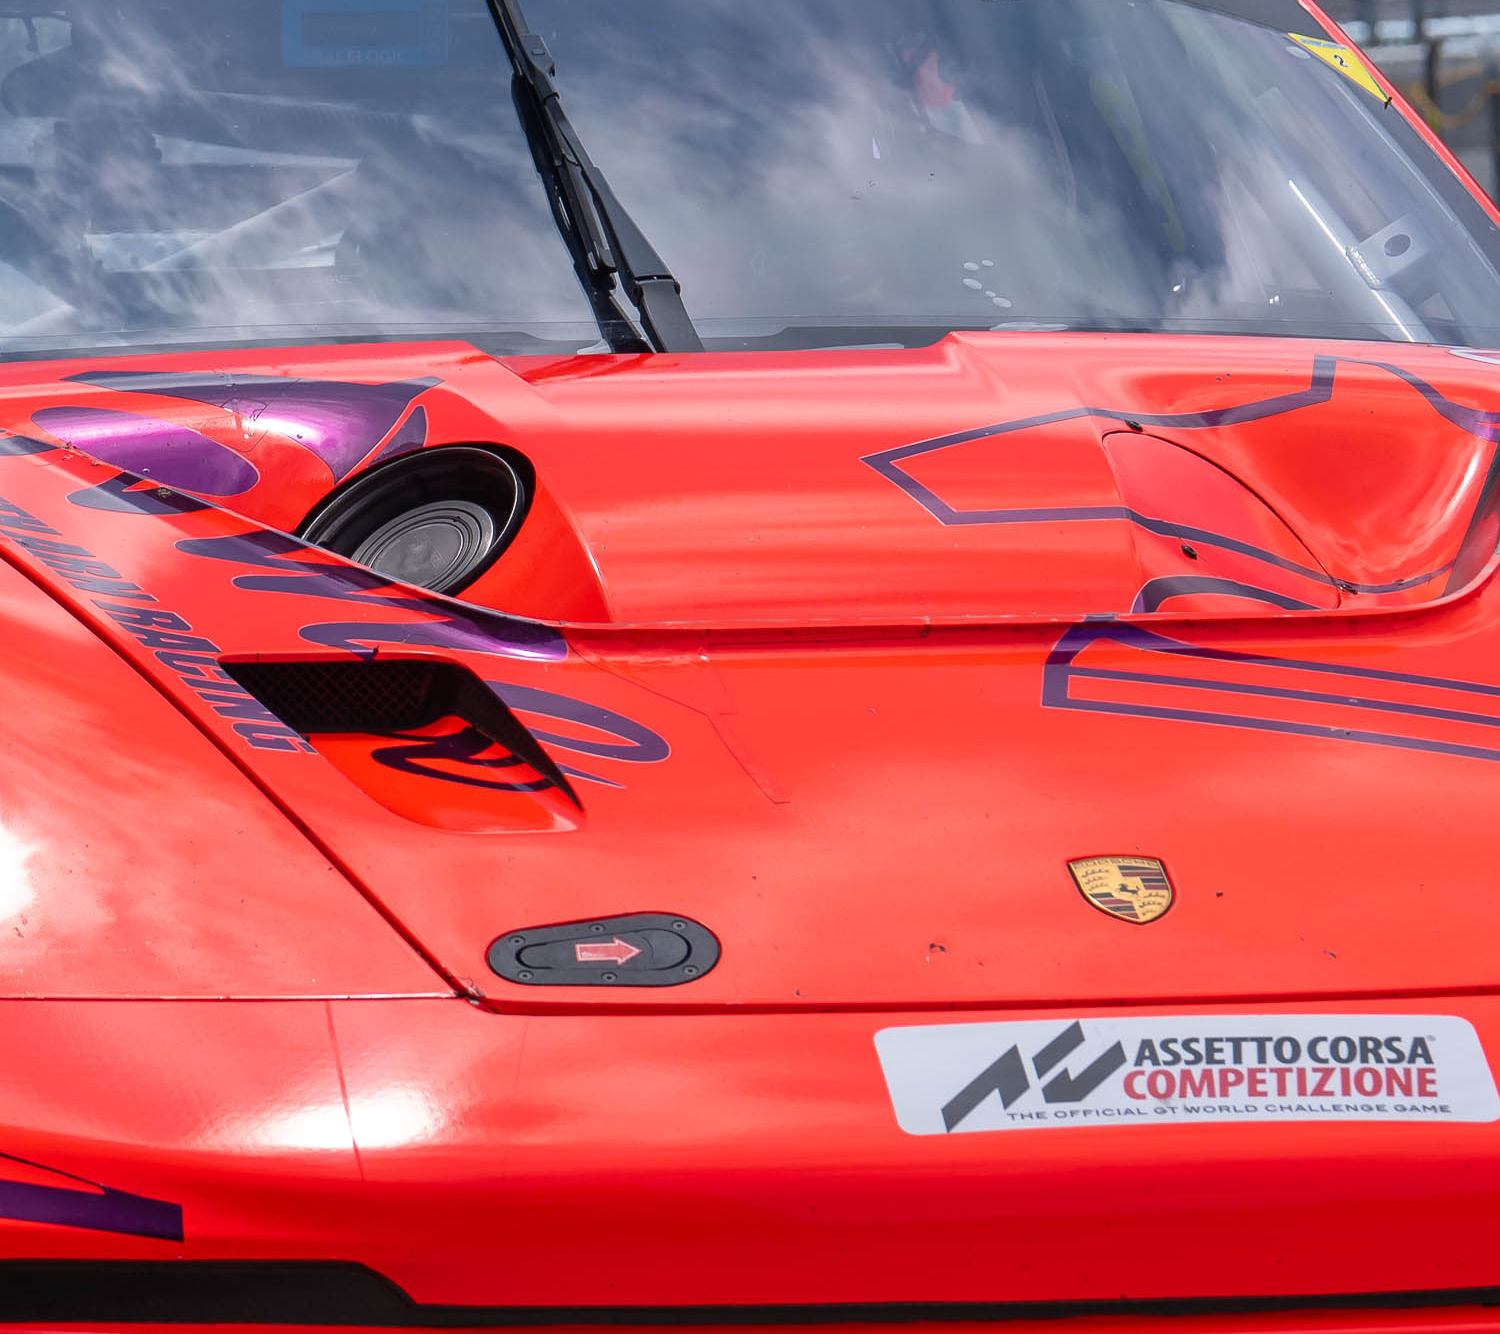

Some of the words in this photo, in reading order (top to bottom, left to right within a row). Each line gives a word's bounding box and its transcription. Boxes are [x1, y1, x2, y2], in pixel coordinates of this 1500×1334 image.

[88, 596, 319, 756] RACING
[1133, 1037, 1301, 1067] ASSETTO
[1307, 1035, 1435, 1065] CORSA
[1122, 1067, 1439, 1099] COMPETIZIONE
[1006, 1111, 1049, 1121] THE
[1053, 1106, 1148, 1119] OFFICIAL
[1153, 1105, 1179, 1115] GT
[1183, 1104, 1260, 1114] WORLD
[1264, 1103, 1388, 1113] CHALLENGE
[1393, 1103, 1452, 1113] GAME
